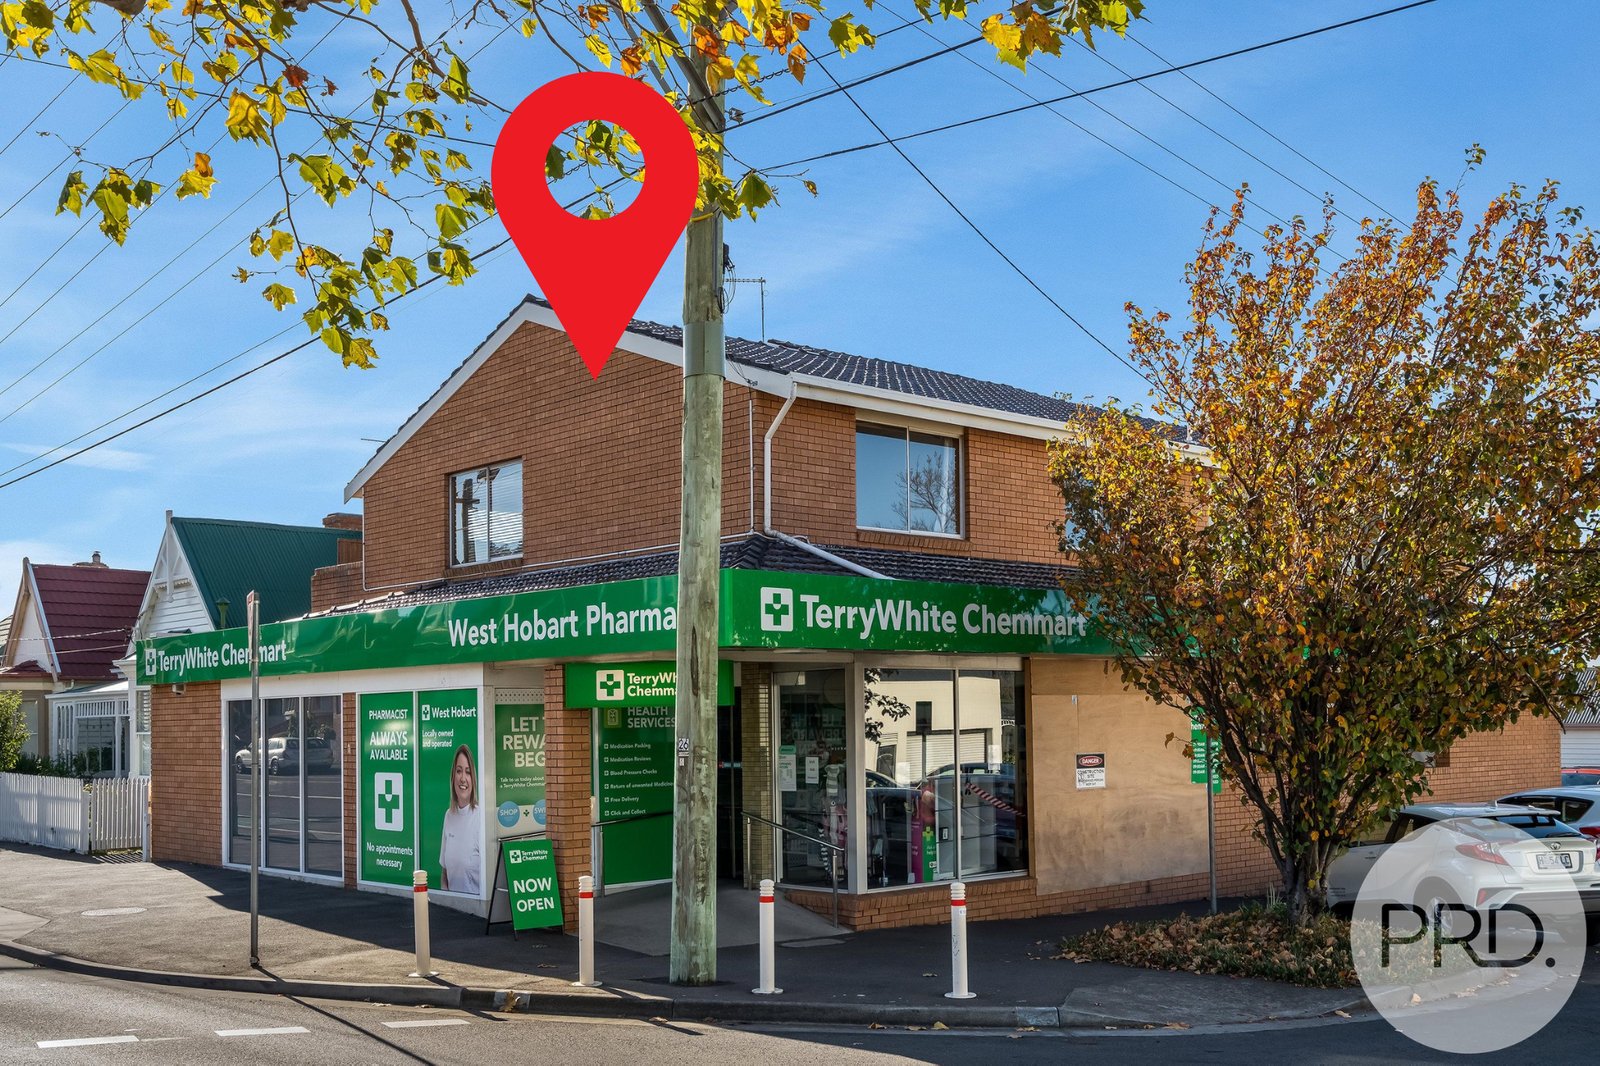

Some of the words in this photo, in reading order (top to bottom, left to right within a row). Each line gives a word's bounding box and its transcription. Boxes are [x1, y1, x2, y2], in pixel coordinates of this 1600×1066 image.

[800, 594, 957, 640] TerryWhite
[962, 603, 1087, 637] Chemmart
[448, 618, 498, 648] West
[503, 608, 579, 643] Hobart
[586, 602, 677, 636] Pharma
[157, 646, 219, 677] TerryWhite
[626, 685, 677, 697] Chemm
[368, 709, 409, 720] PHARMACIST
[431, 707, 450, 718] West
[451, 705, 477, 718] Hobart
[627, 706, 668, 716] HEALTH
[511, 716, 539, 732] LET
[369, 731, 408, 746] ALWAYS
[422, 729, 438, 739] Locally
[438, 728, 454, 737] owned
[422, 739, 431, 748] and
[431, 739, 453, 749] operated
[679, 739, 689, 750] 26
[369, 749, 408, 761] AVAILABLE
[514, 751, 546, 768] BEG
[520, 776, 532, 784] today
[499, 808, 518, 817] SHOP
[366, 841, 376, 851] No
[376, 844, 413, 856] appointments
[521, 849, 549, 857] TerryWhite
[376, 858, 403, 871] necessary
[513, 877, 552, 894] NOW
[516, 897, 555, 913] OPEN
